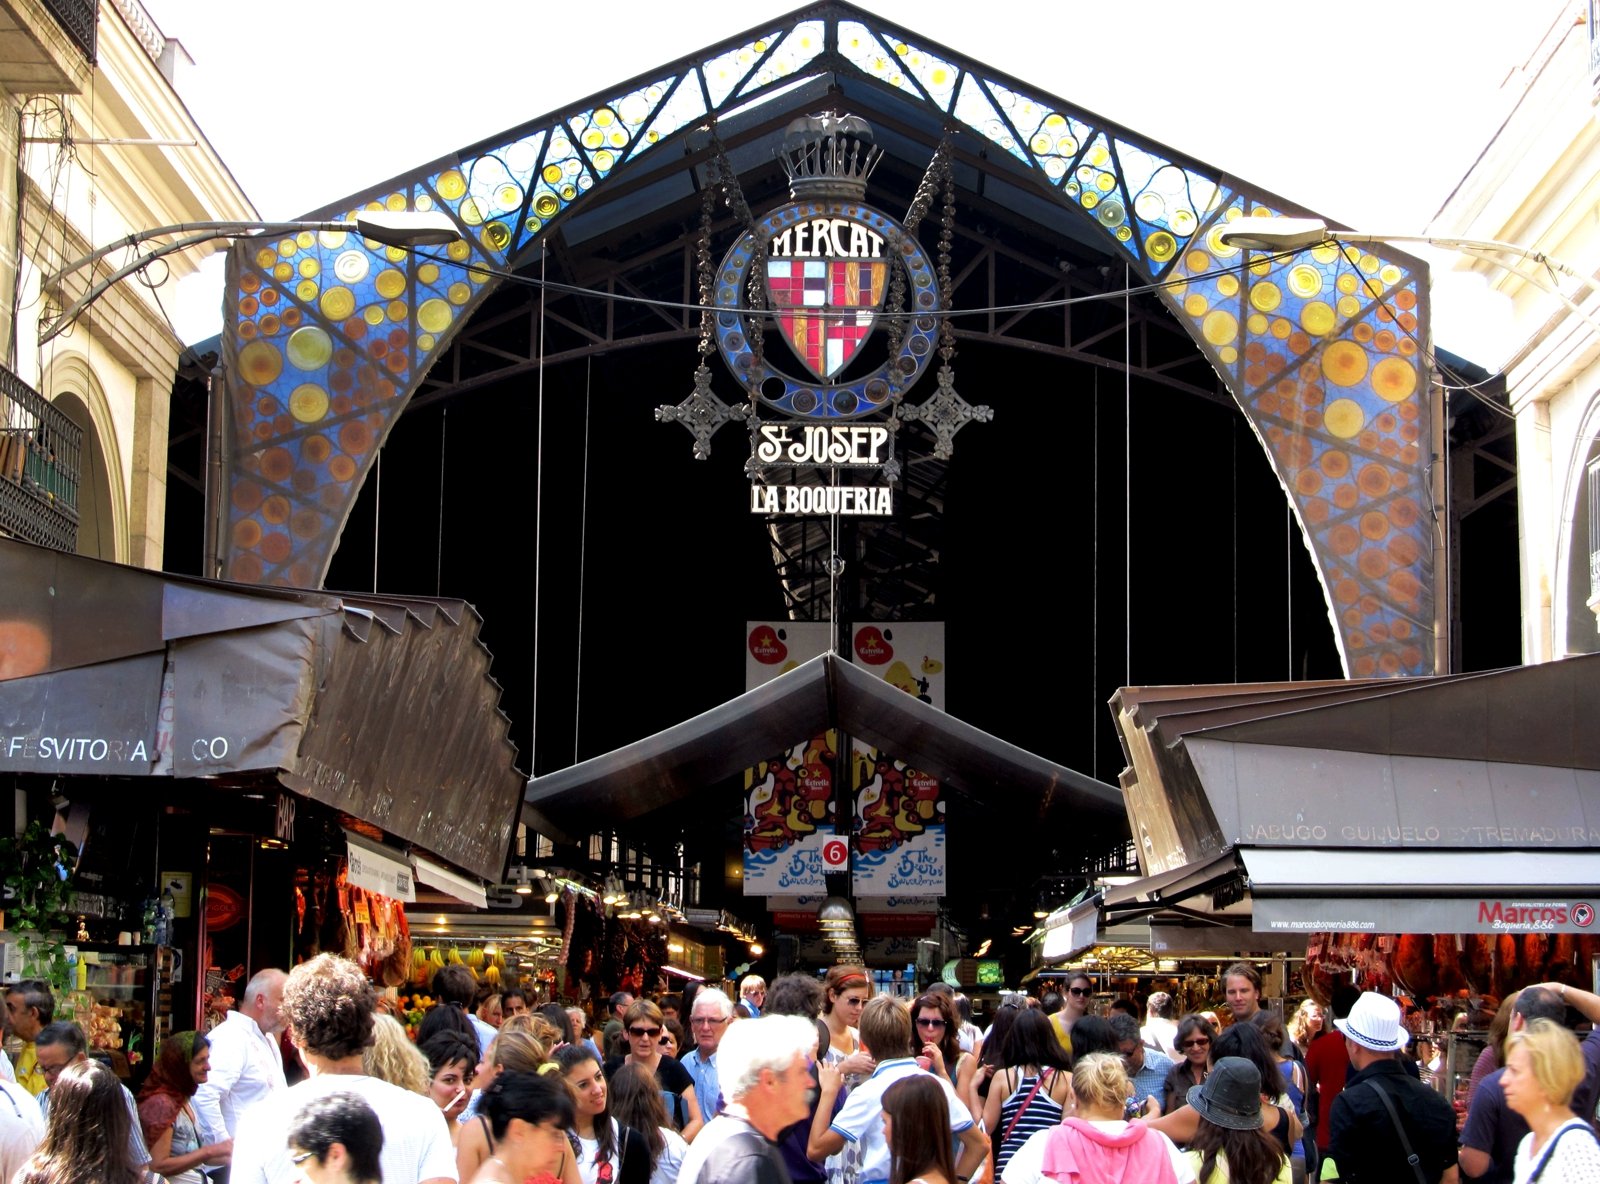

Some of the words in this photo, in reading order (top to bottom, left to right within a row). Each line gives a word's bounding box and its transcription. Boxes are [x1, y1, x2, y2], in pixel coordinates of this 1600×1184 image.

[772, 218, 885, 258] MERCAT
[788, 426, 888, 463] JOSEP
[751, 486, 779, 513] LA
[785, 486, 892, 514] BOQUERIA
[805, 779, 829, 787] Estrella
[913, 779, 937, 787] Estrella
[278, 793, 295, 841] BAR
[1246, 825, 1327, 841] JABUGO
[1341, 825, 1440, 842] GUIJUELO
[829, 844, 841, 861] 6
[1478, 901, 1568, 924] Marcos
